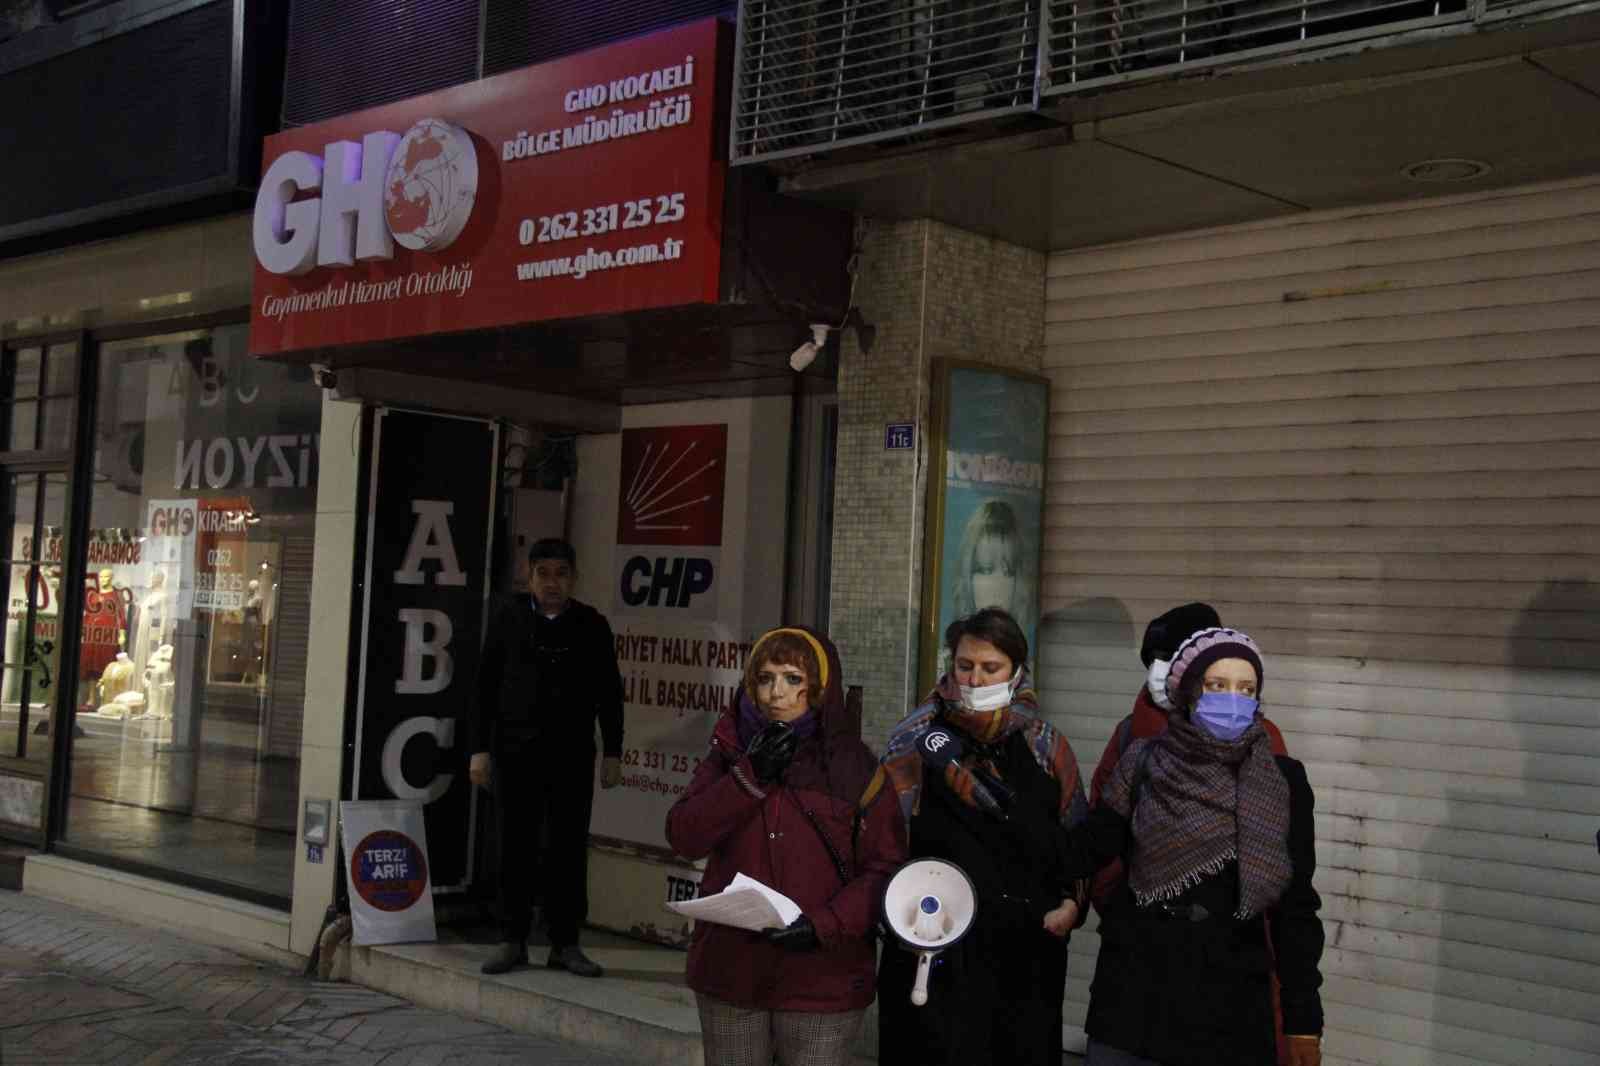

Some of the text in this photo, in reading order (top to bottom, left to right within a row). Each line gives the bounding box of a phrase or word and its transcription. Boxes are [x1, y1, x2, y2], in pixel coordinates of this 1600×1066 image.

[564, 55, 694, 113] GHO KOCAELİ
[502, 94, 692, 161] BÖLGE MÜDÜRLÜĞÜ
[253, 118, 479, 277] GHO
[519, 192, 685, 246] 0 262 331 25 25
[517, 237, 684, 280] www.gho.com.tr
[349, 274, 401, 306] Hizmet
[405, 262, 473, 298] Ortaklığı
[621, 556, 713, 607] CHP
[616, 627, 752, 670] RİYET HALK PART
[639, 671, 652, 705] İL
[624, 749, 640, 766] 62
[643, 751, 666, 770] 331
[672, 755, 689, 773] 25
